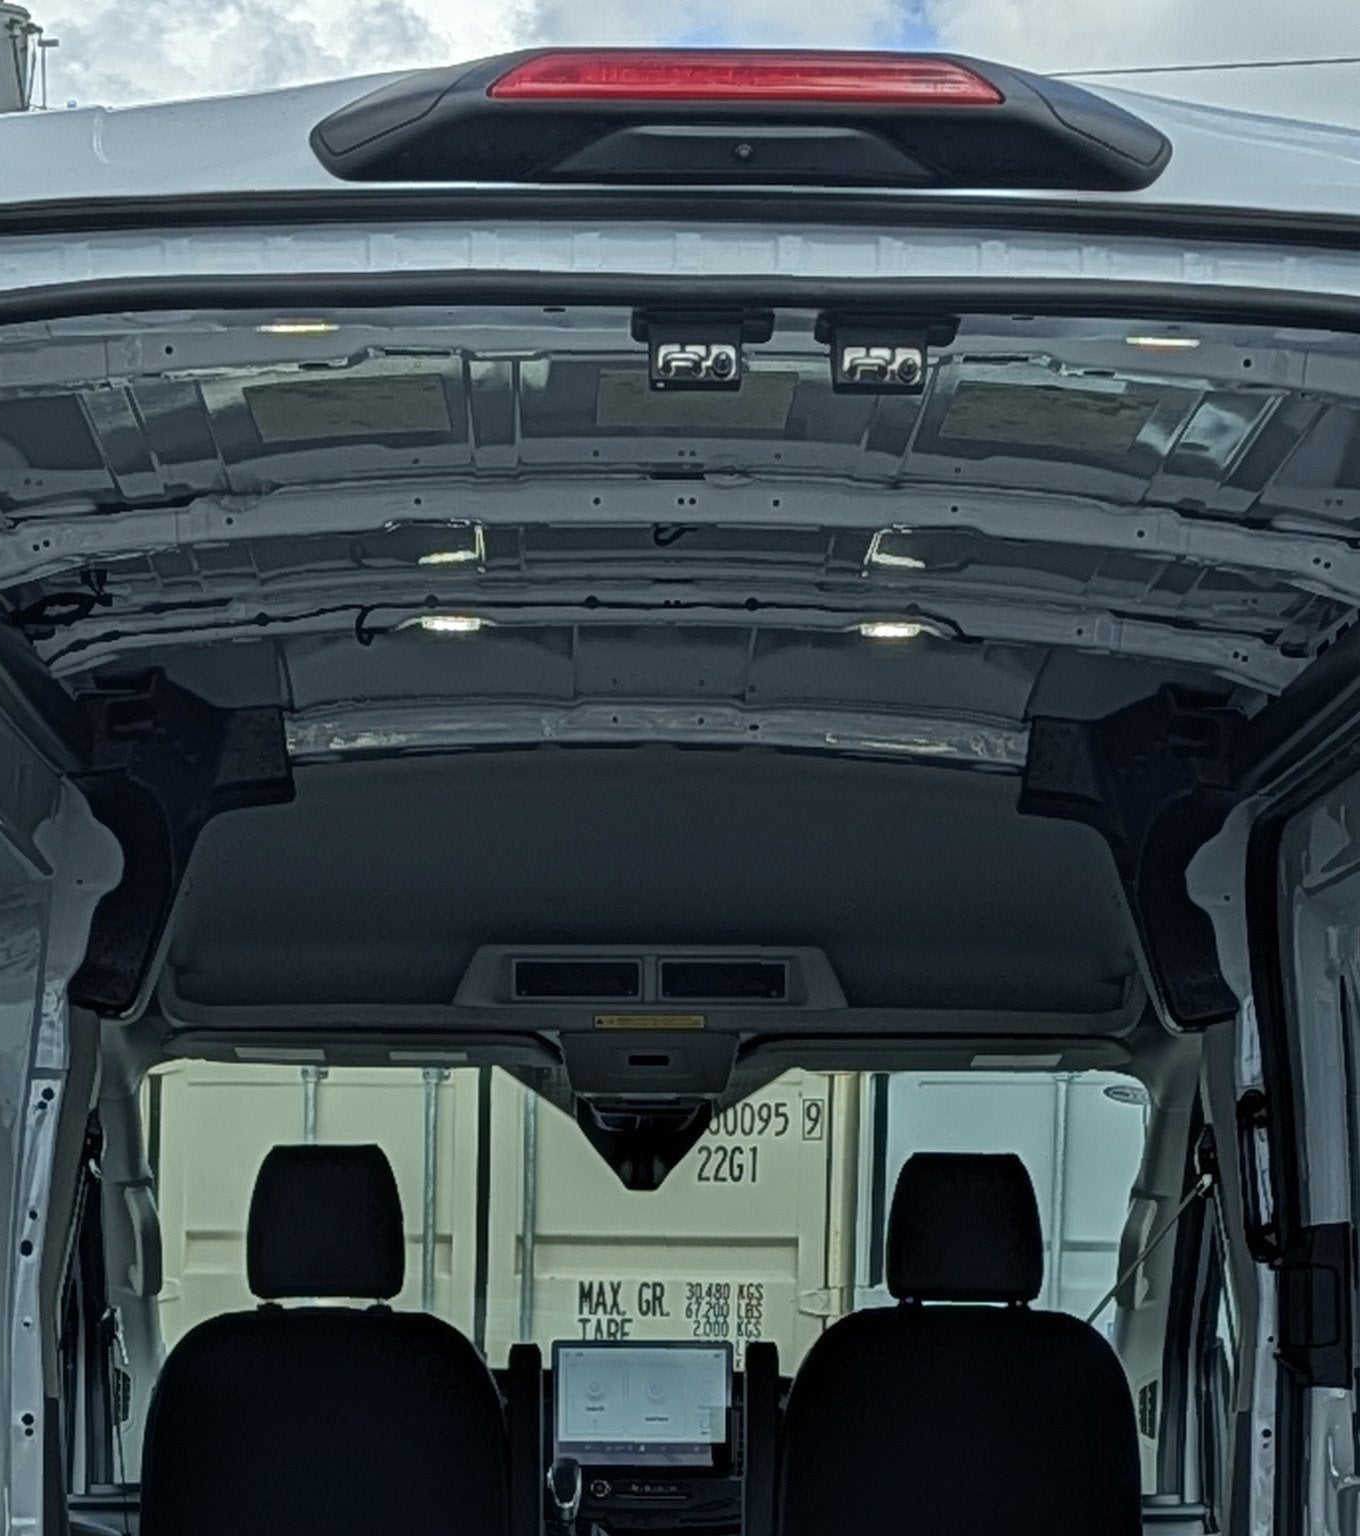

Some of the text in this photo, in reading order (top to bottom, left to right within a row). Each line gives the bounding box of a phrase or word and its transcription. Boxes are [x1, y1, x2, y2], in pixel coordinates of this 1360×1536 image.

[806, 1102, 821, 1135] 9
[697, 1145, 758, 1183] 22G1
[578, 1280, 627, 1316] MAX.
[638, 1282, 671, 1317] GR.
[737, 1282, 764, 1300] KGS
[737, 1302, 763, 1319] LBS
[577, 1318, 633, 1340] TARE
[736, 1320, 762, 1338] KGS
